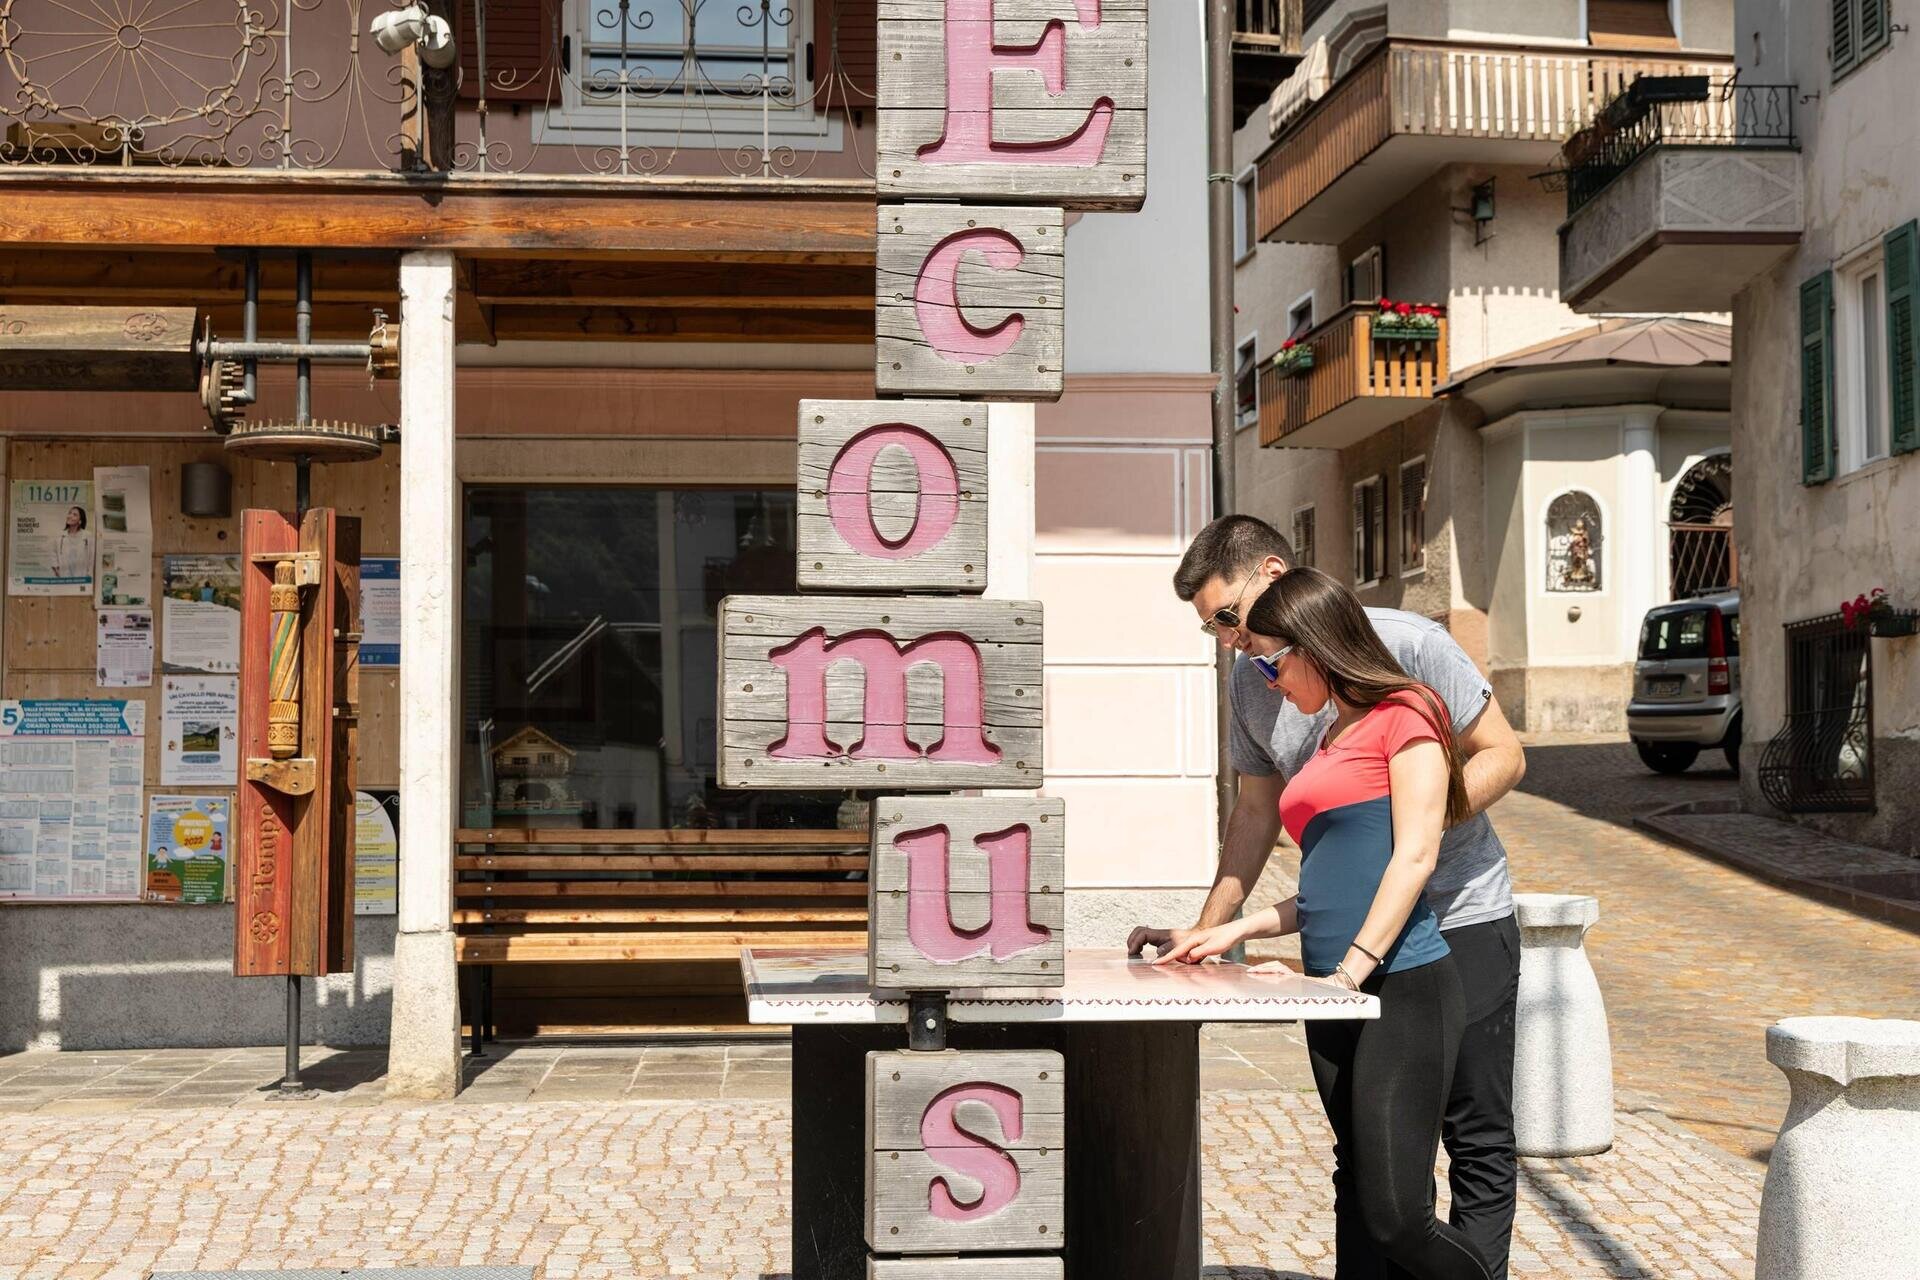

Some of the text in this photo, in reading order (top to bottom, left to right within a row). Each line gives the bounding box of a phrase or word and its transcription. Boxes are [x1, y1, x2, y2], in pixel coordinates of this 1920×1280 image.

[28, 486, 80, 501] 116117
[3, 708, 18, 726] 5
[183, 836, 204, 847] 2022
[251, 801, 282, 897] Tempo
